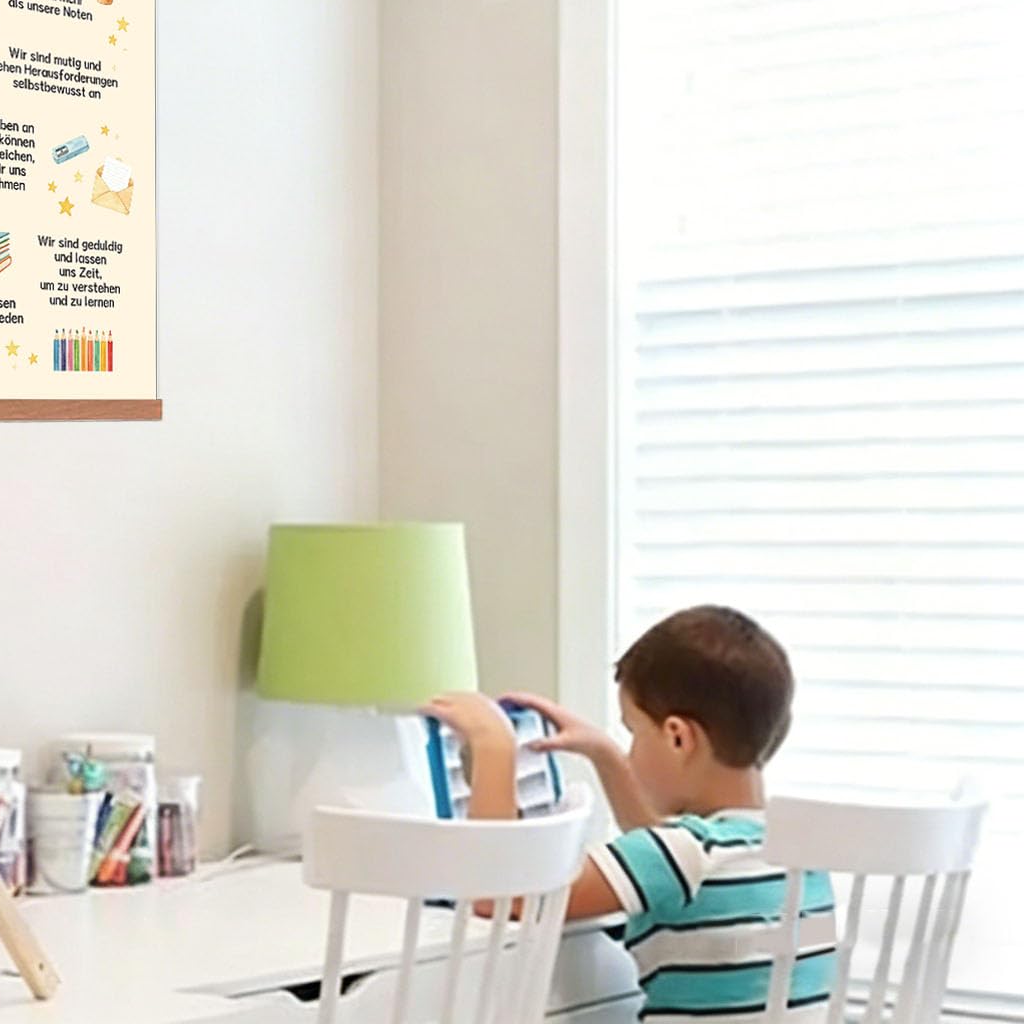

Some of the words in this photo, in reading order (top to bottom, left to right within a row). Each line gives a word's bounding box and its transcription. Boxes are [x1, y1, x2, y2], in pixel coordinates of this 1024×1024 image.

[27, 2, 60, 15] unsere
[63, 6, 93, 21] Noten
[9, 47, 27, 60] Wir
[30, 52, 51, 64] sind
[54, 57, 81, 70] mutig
[84, 61, 101, 71] und
[24, 64, 118, 88] Herausforderungen
[13, 78, 85, 97] selbstbewusst
[88, 90, 101, 99] an
[22, 124, 34, 134] an
[9, 167, 26, 176] uns
[38, 235, 55, 247] Wir
[58, 238, 79, 249] sind
[82, 240, 123, 254] geduldig
[54, 252, 73, 263] und
[75, 252, 107, 265] lassen
[40, 282, 54, 291] um
[57, 282, 69, 291] zu
[72, 282, 120, 294] verstehen
[49, 295, 68, 306] und
[70, 298, 82, 307] zu
[85, 296, 114, 308] lernen
